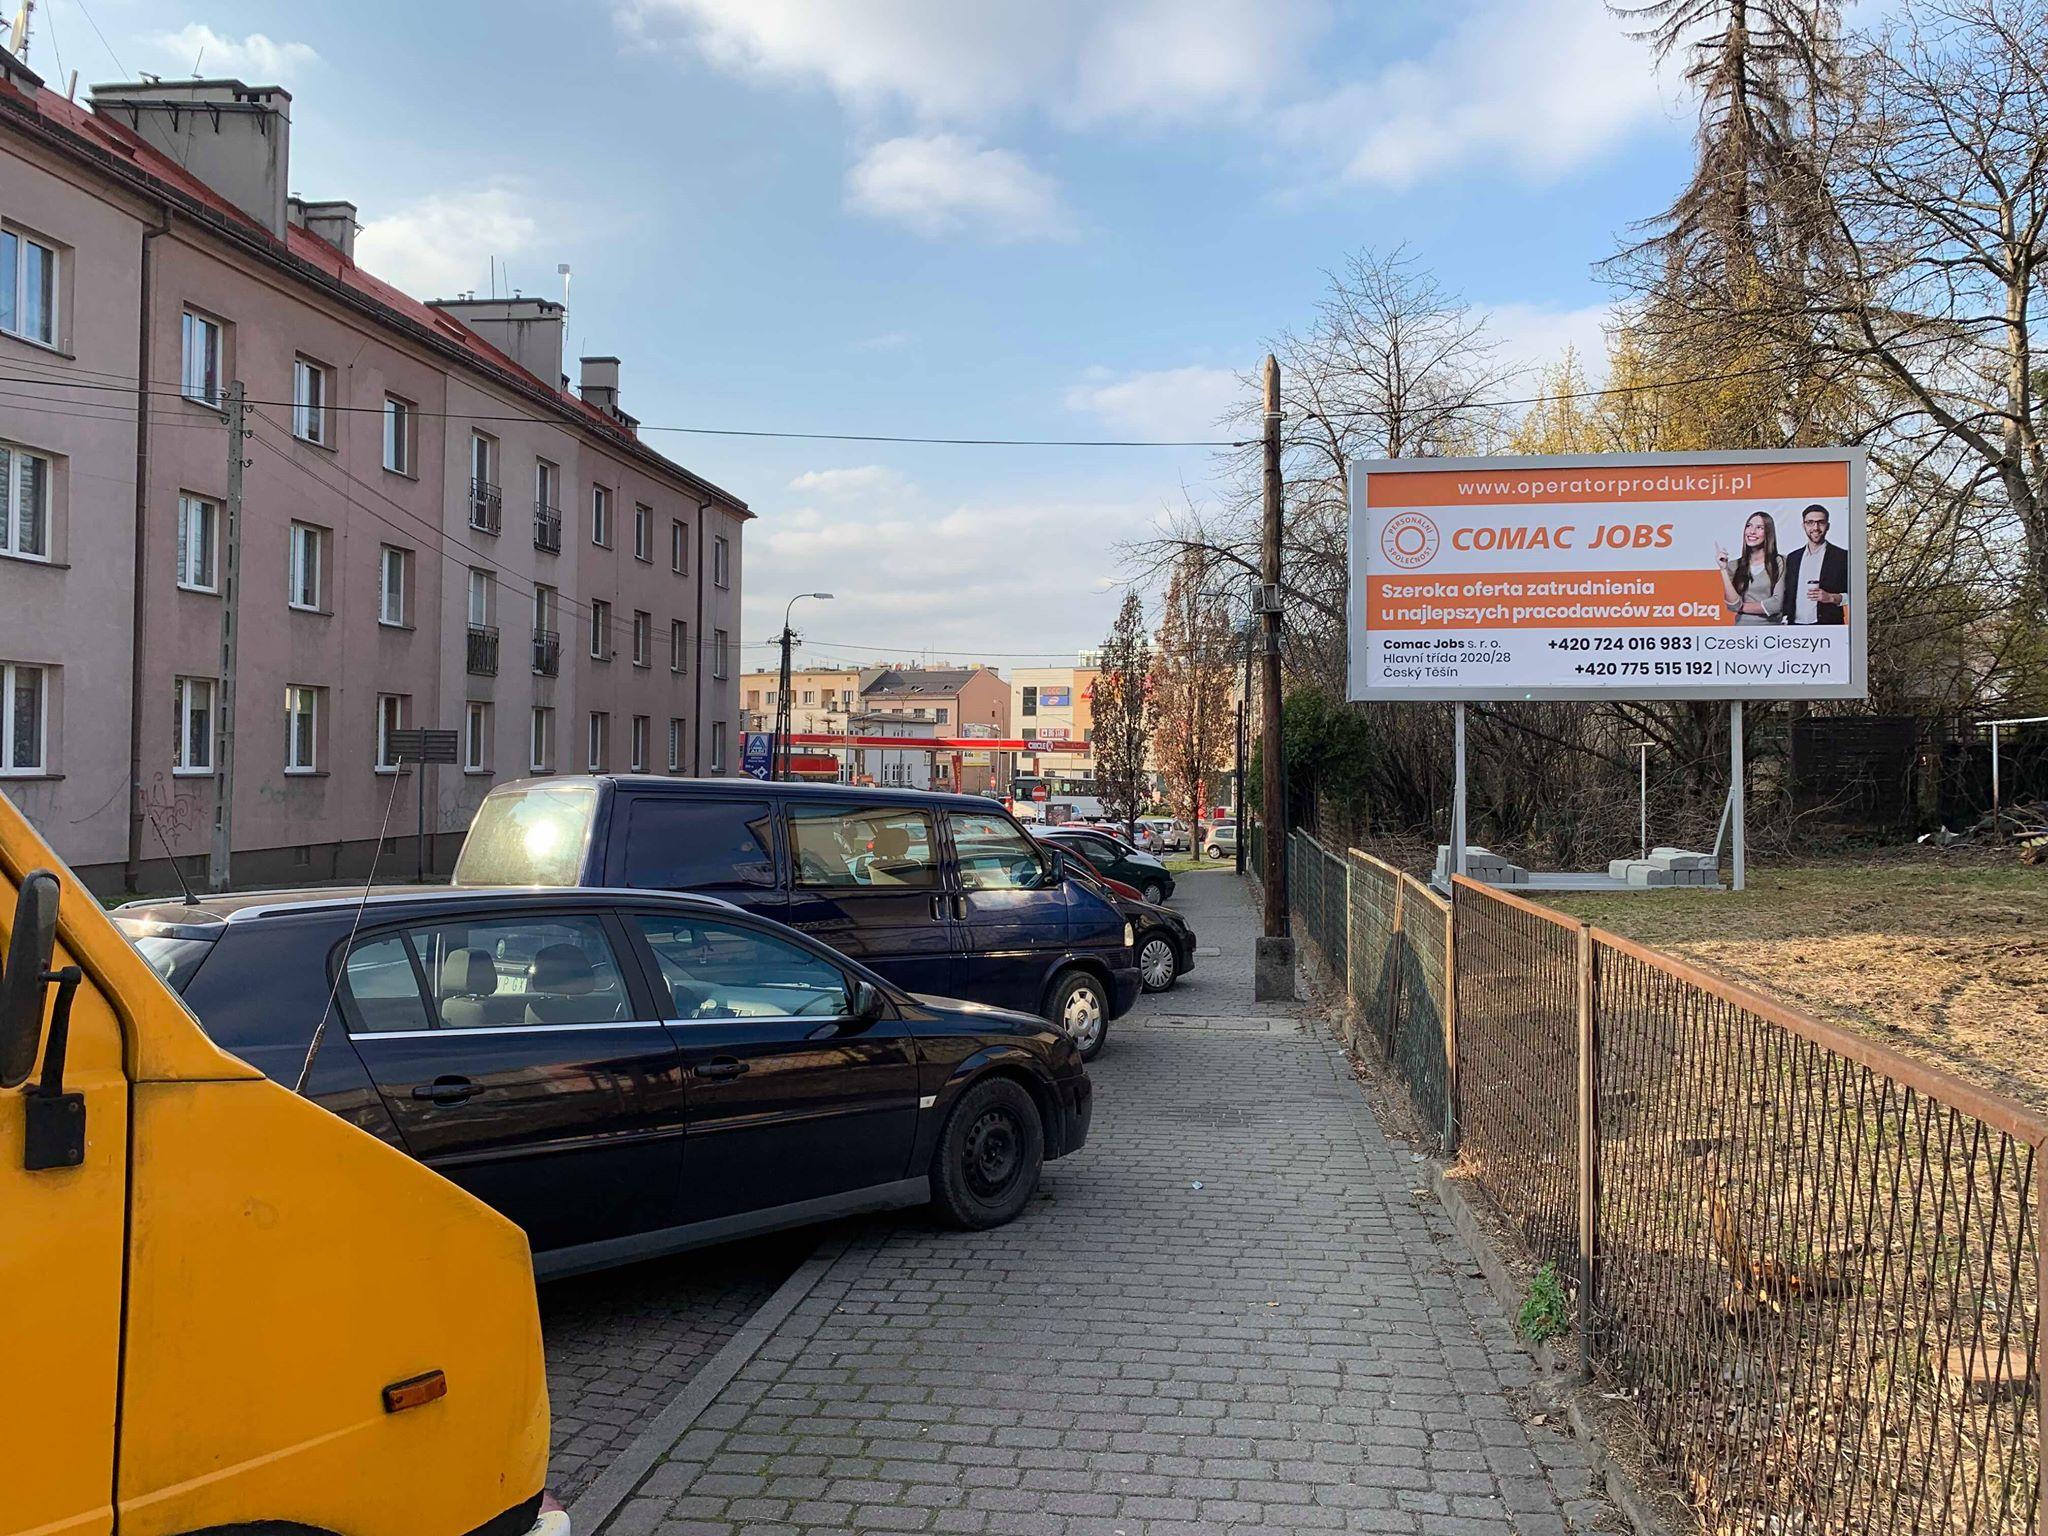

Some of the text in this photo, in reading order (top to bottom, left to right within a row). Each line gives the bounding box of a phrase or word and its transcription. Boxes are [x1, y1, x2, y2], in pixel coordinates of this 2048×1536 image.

[1458, 473, 1752, 497] www.operatorprodukcji.pl
[1452, 523, 1674, 551] COMAC JOBS
[1382, 578, 1655, 598] Szeroka oferta zatrudnienia
[1382, 601, 1721, 625] u najlepszych pracodawców za Olzą
[1383, 638, 1501, 649] Comac Jobs s. r. o.
[1548, 635, 1831, 653] +420 724 016 983 Czeski Cieszyn
[1383, 650, 1511, 664] Hlavní třída 2020/28
[1383, 664, 1459, 680] Český Těšín
[1574, 660, 1831, 678] +420 775 515 192 Nowy Jiczyn
